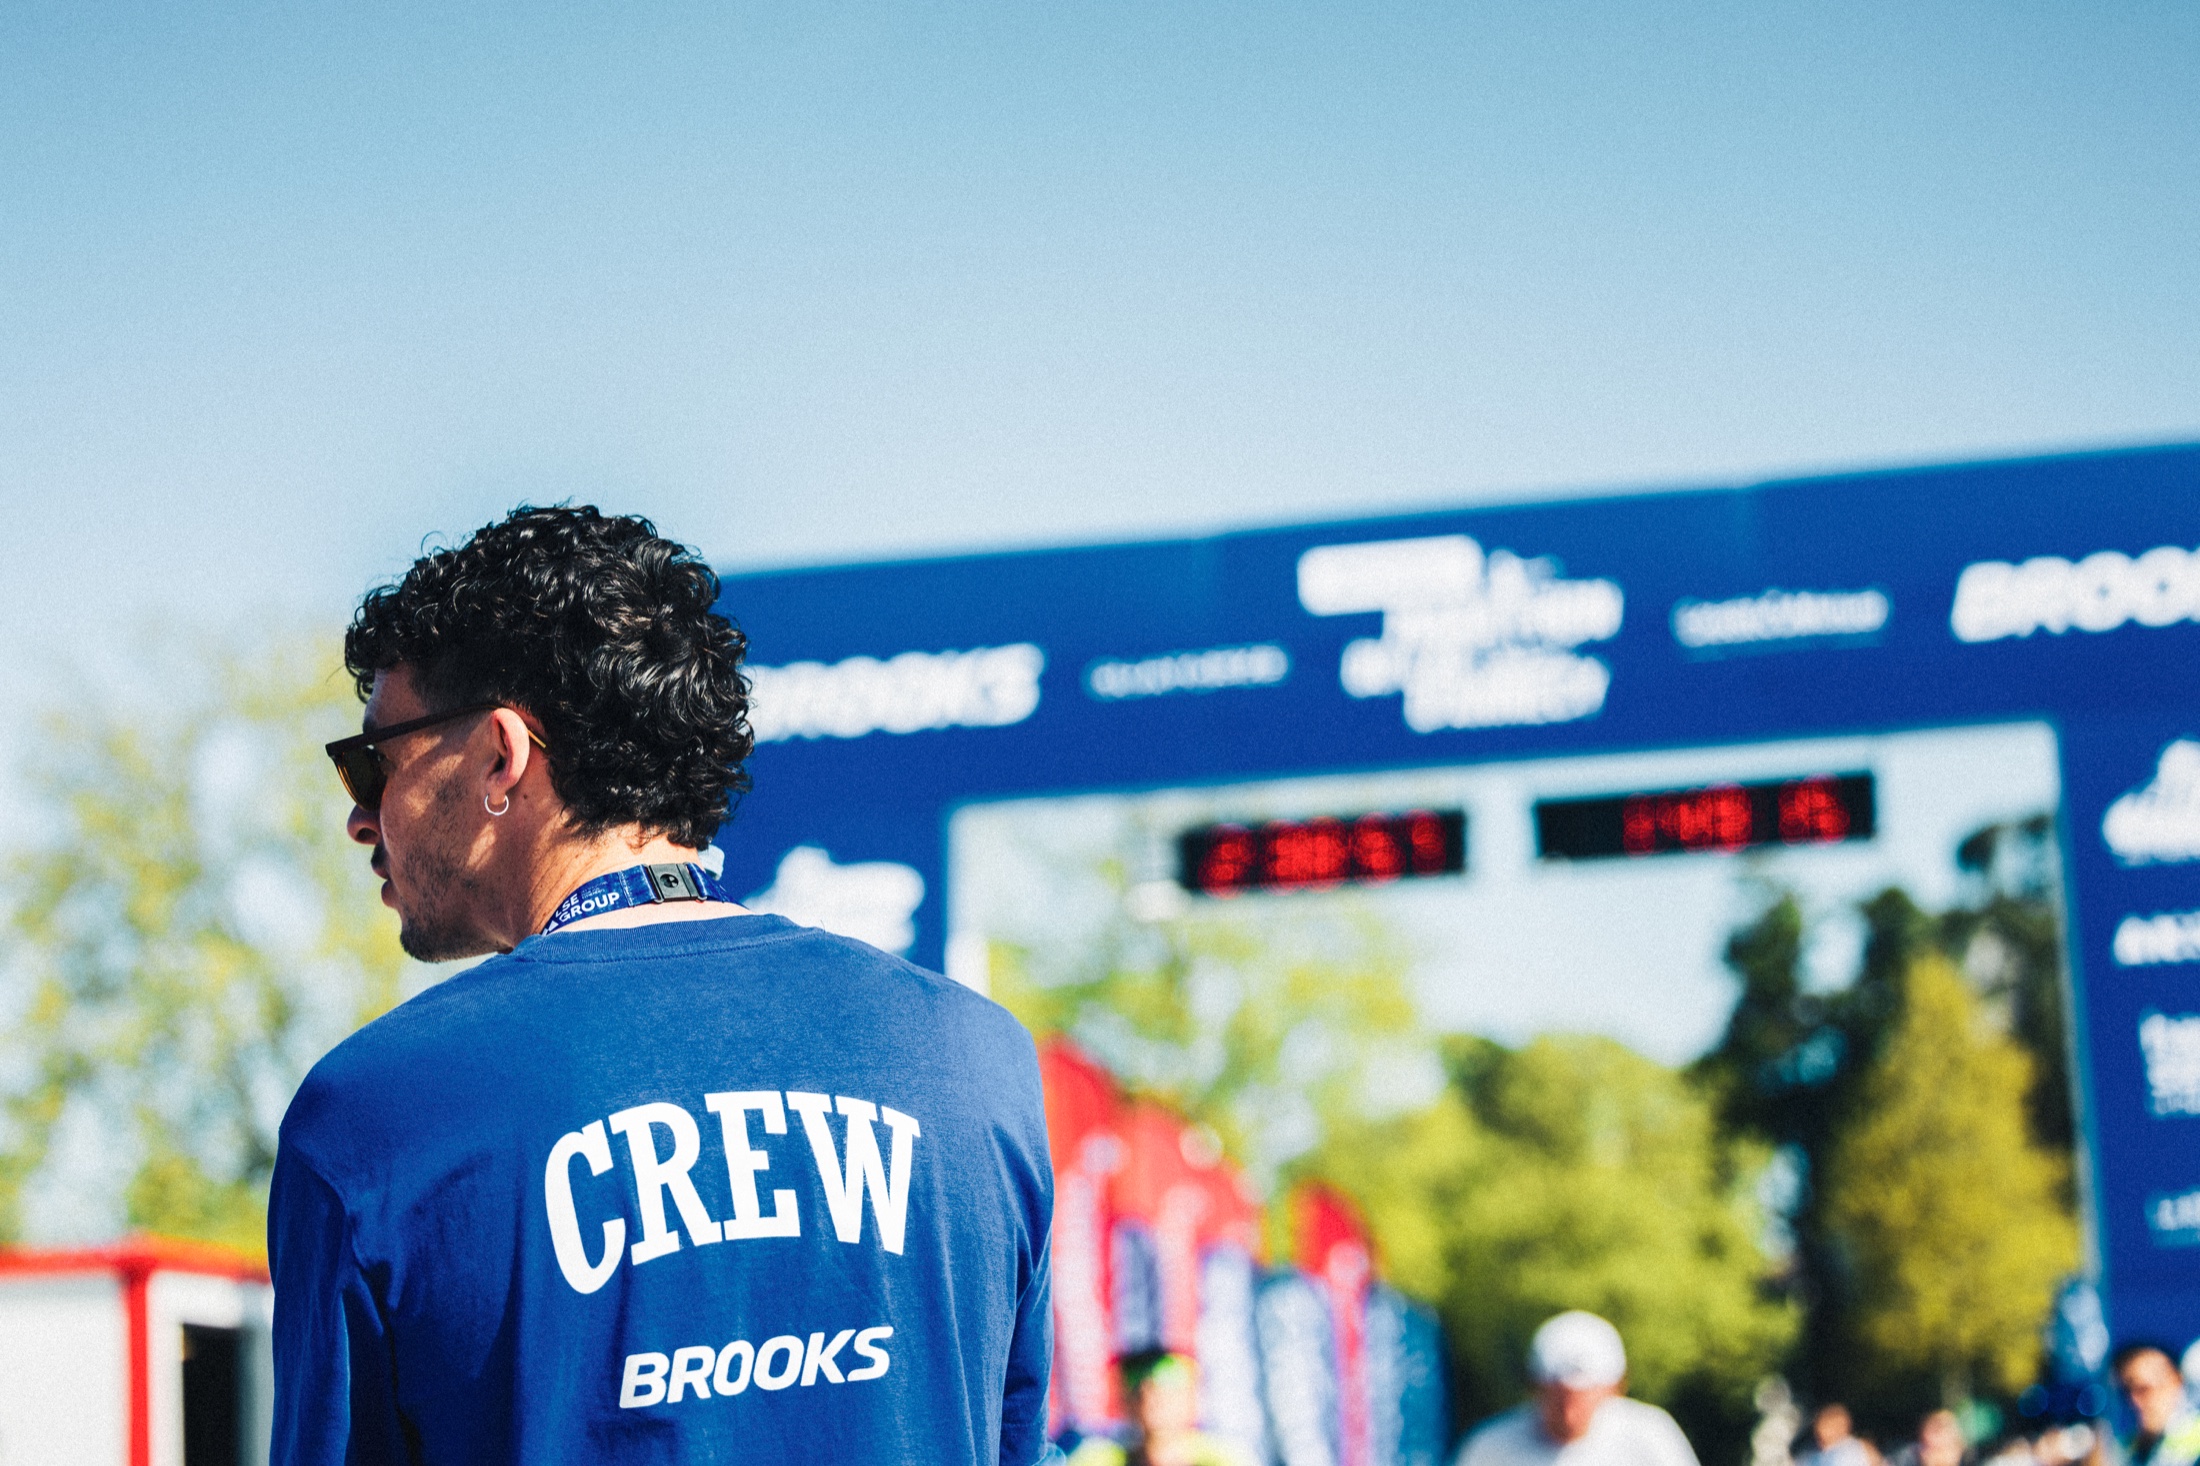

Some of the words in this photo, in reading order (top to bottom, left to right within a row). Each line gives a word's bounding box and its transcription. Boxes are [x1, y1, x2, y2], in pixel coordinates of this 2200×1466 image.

[1951, 546, 2200, 643] BROO
[559, 892, 620, 922] GROUP
[545, 1090, 921, 1294] CREW
[619, 1326, 894, 1409] BROOKS
